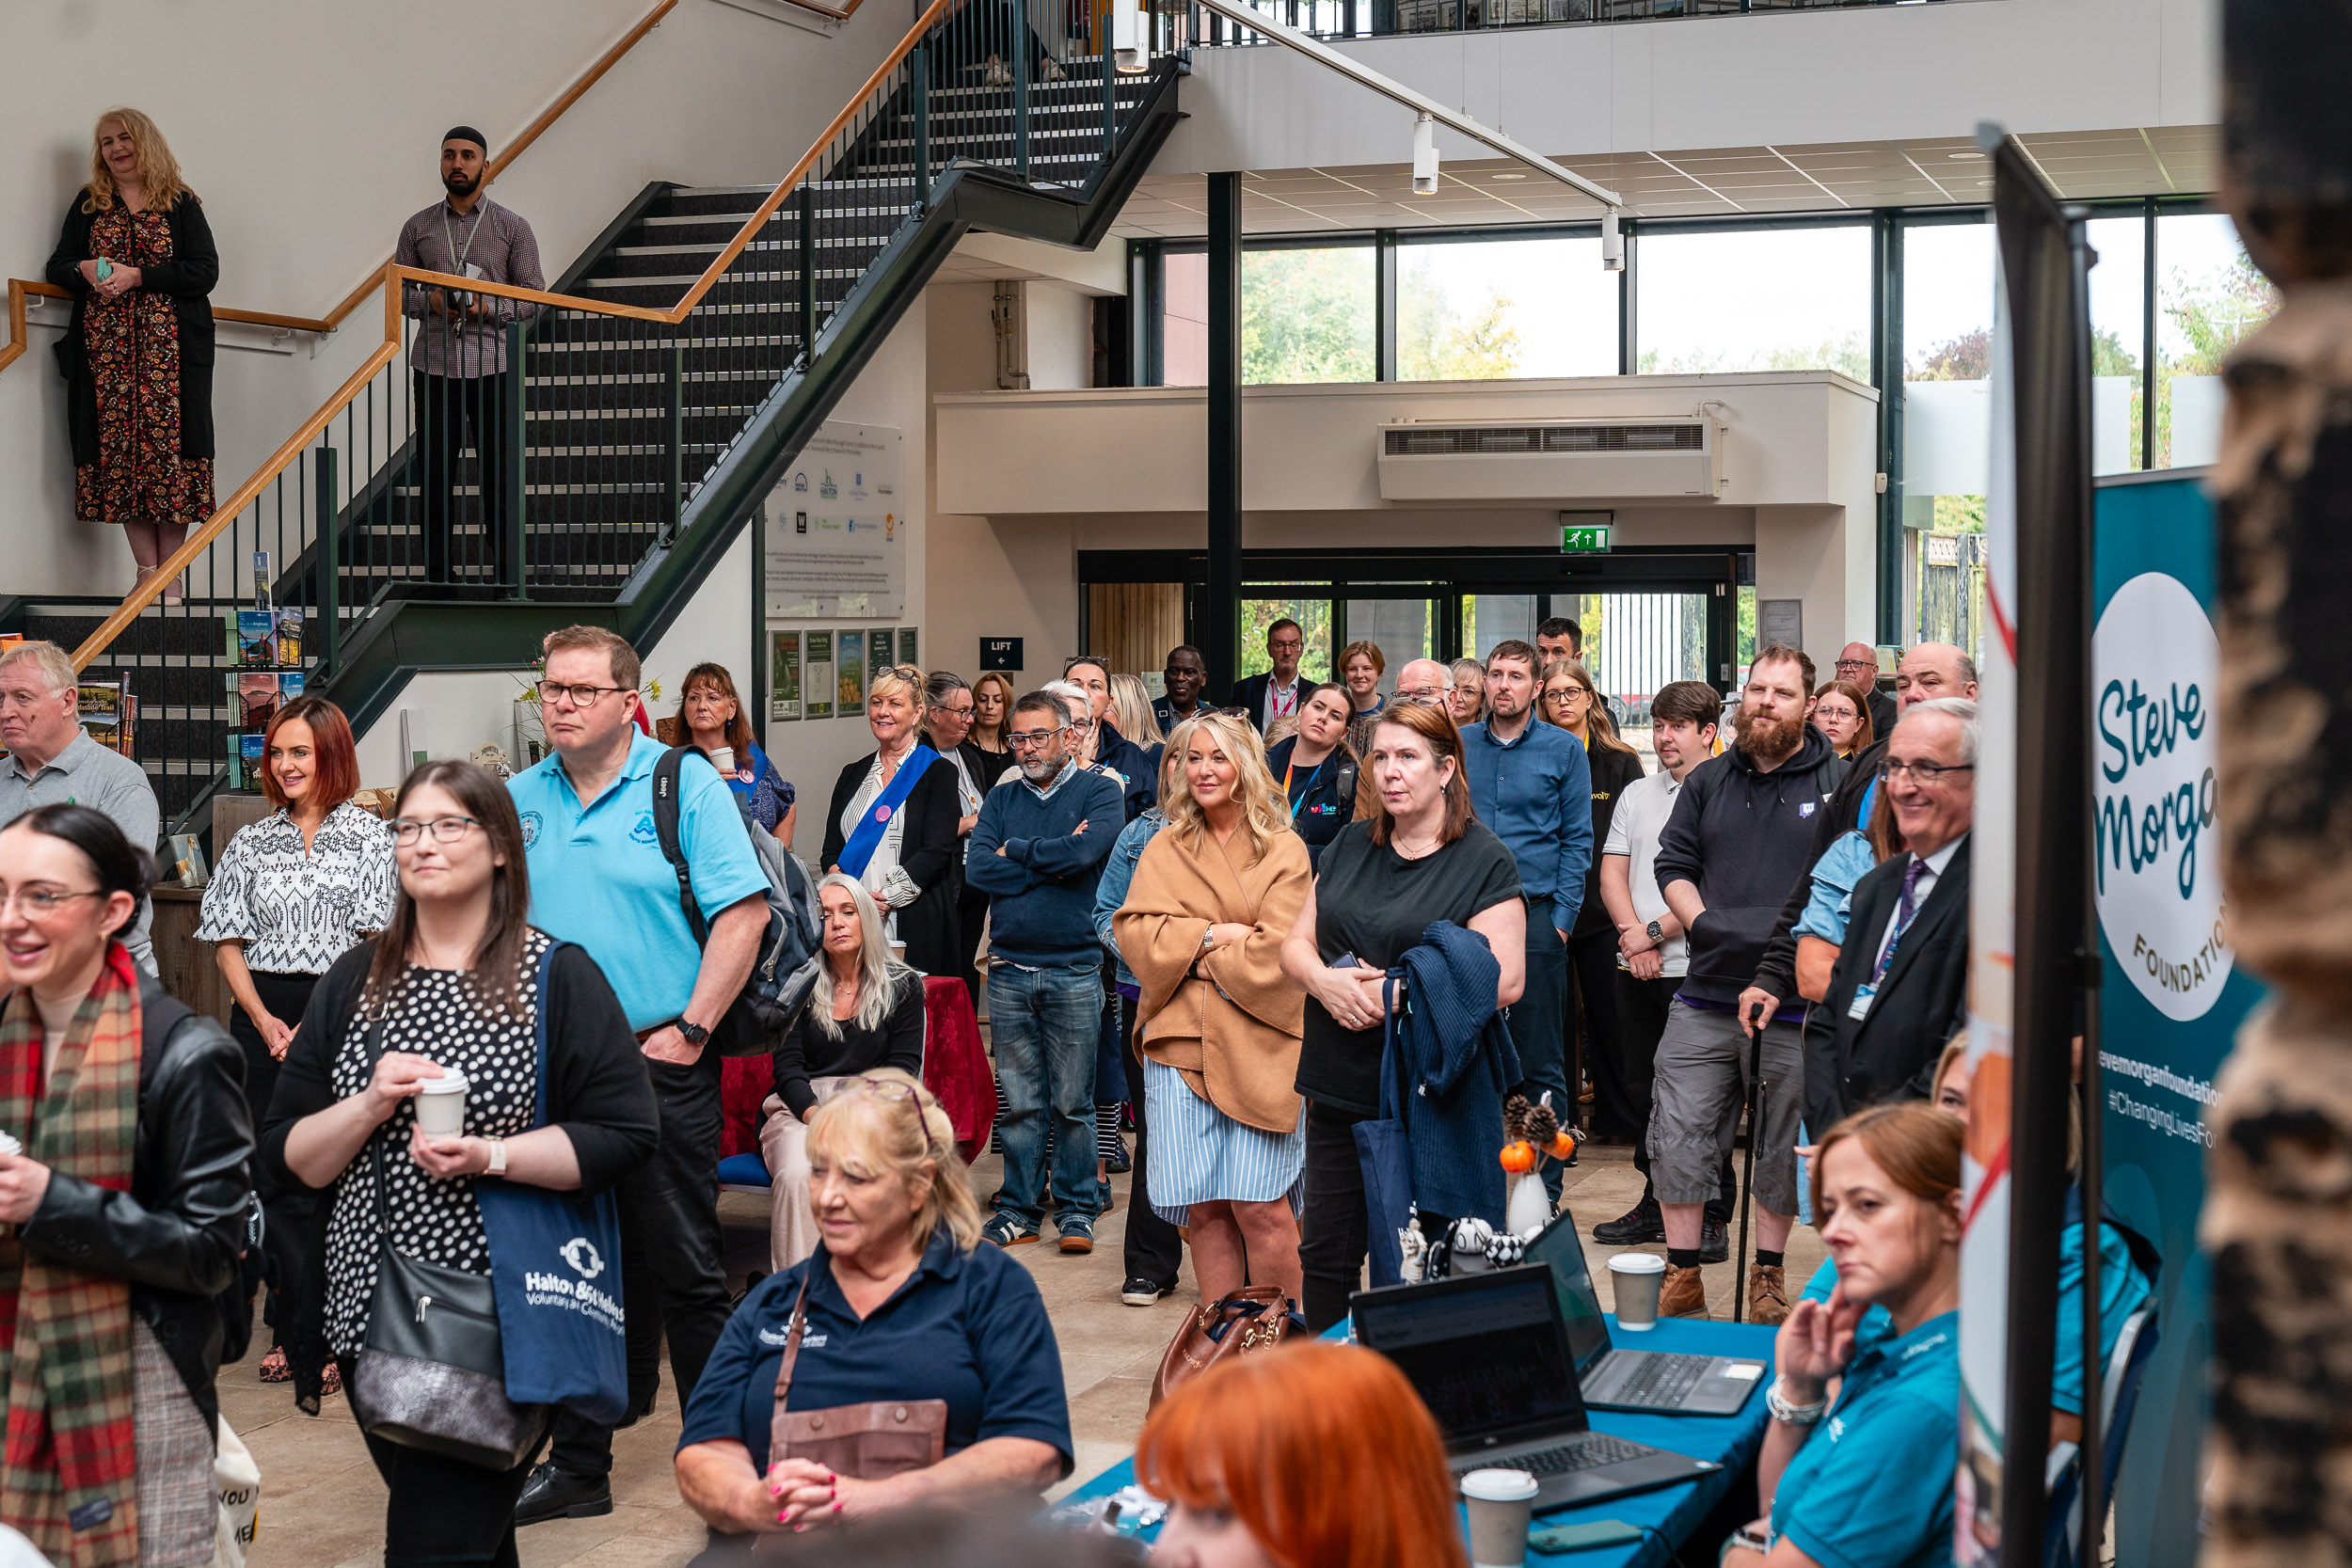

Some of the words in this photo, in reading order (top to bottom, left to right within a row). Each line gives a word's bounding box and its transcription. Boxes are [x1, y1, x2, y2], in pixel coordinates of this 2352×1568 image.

[991, 641, 1011, 651] LIFT
[2099, 678, 2206, 784] Steve
[659, 776, 669, 798] Jeep
[1311, 802, 1337, 814] vibe
[2093, 766, 2221, 901] Morga
